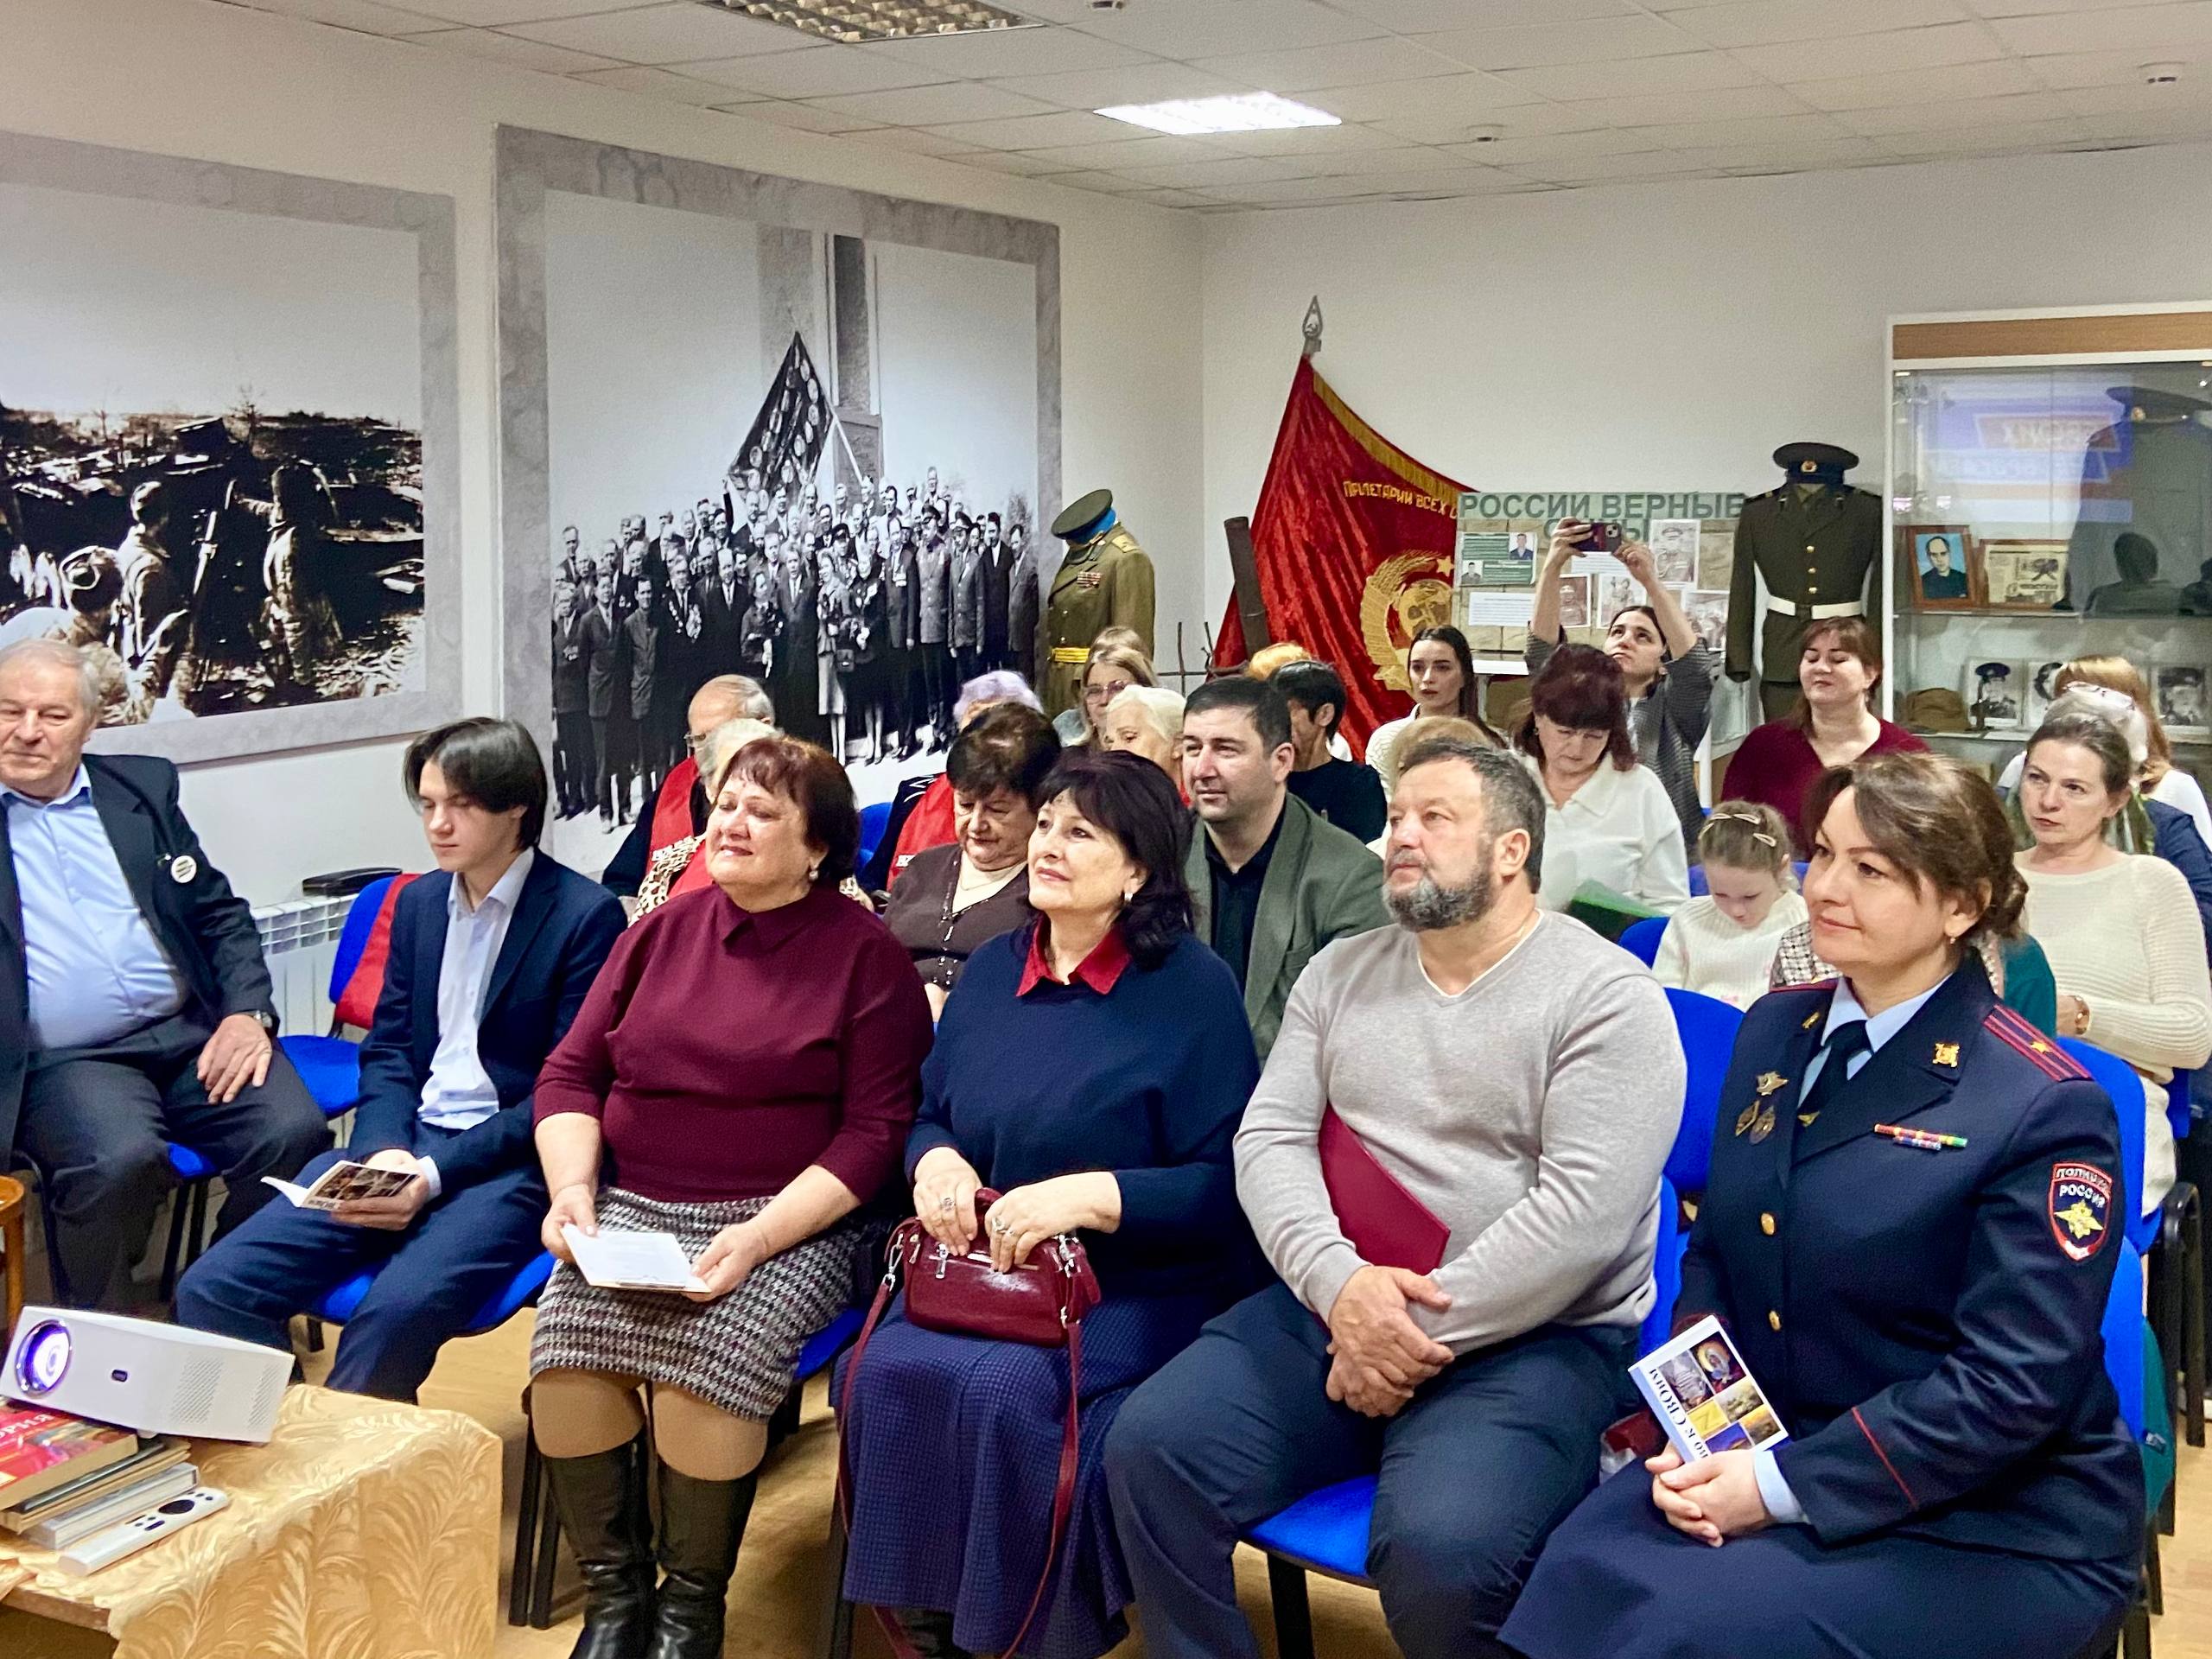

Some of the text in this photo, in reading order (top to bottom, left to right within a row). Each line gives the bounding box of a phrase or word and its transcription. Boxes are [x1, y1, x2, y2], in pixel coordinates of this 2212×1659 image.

[1415, 494, 1449, 516] ВСЕХ
[1459, 493, 1591, 518] РОССИИ
[1602, 493, 1744, 518] ВЕРНЫЕ
[2059, 1184, 2106, 1208] РОССИЯ
